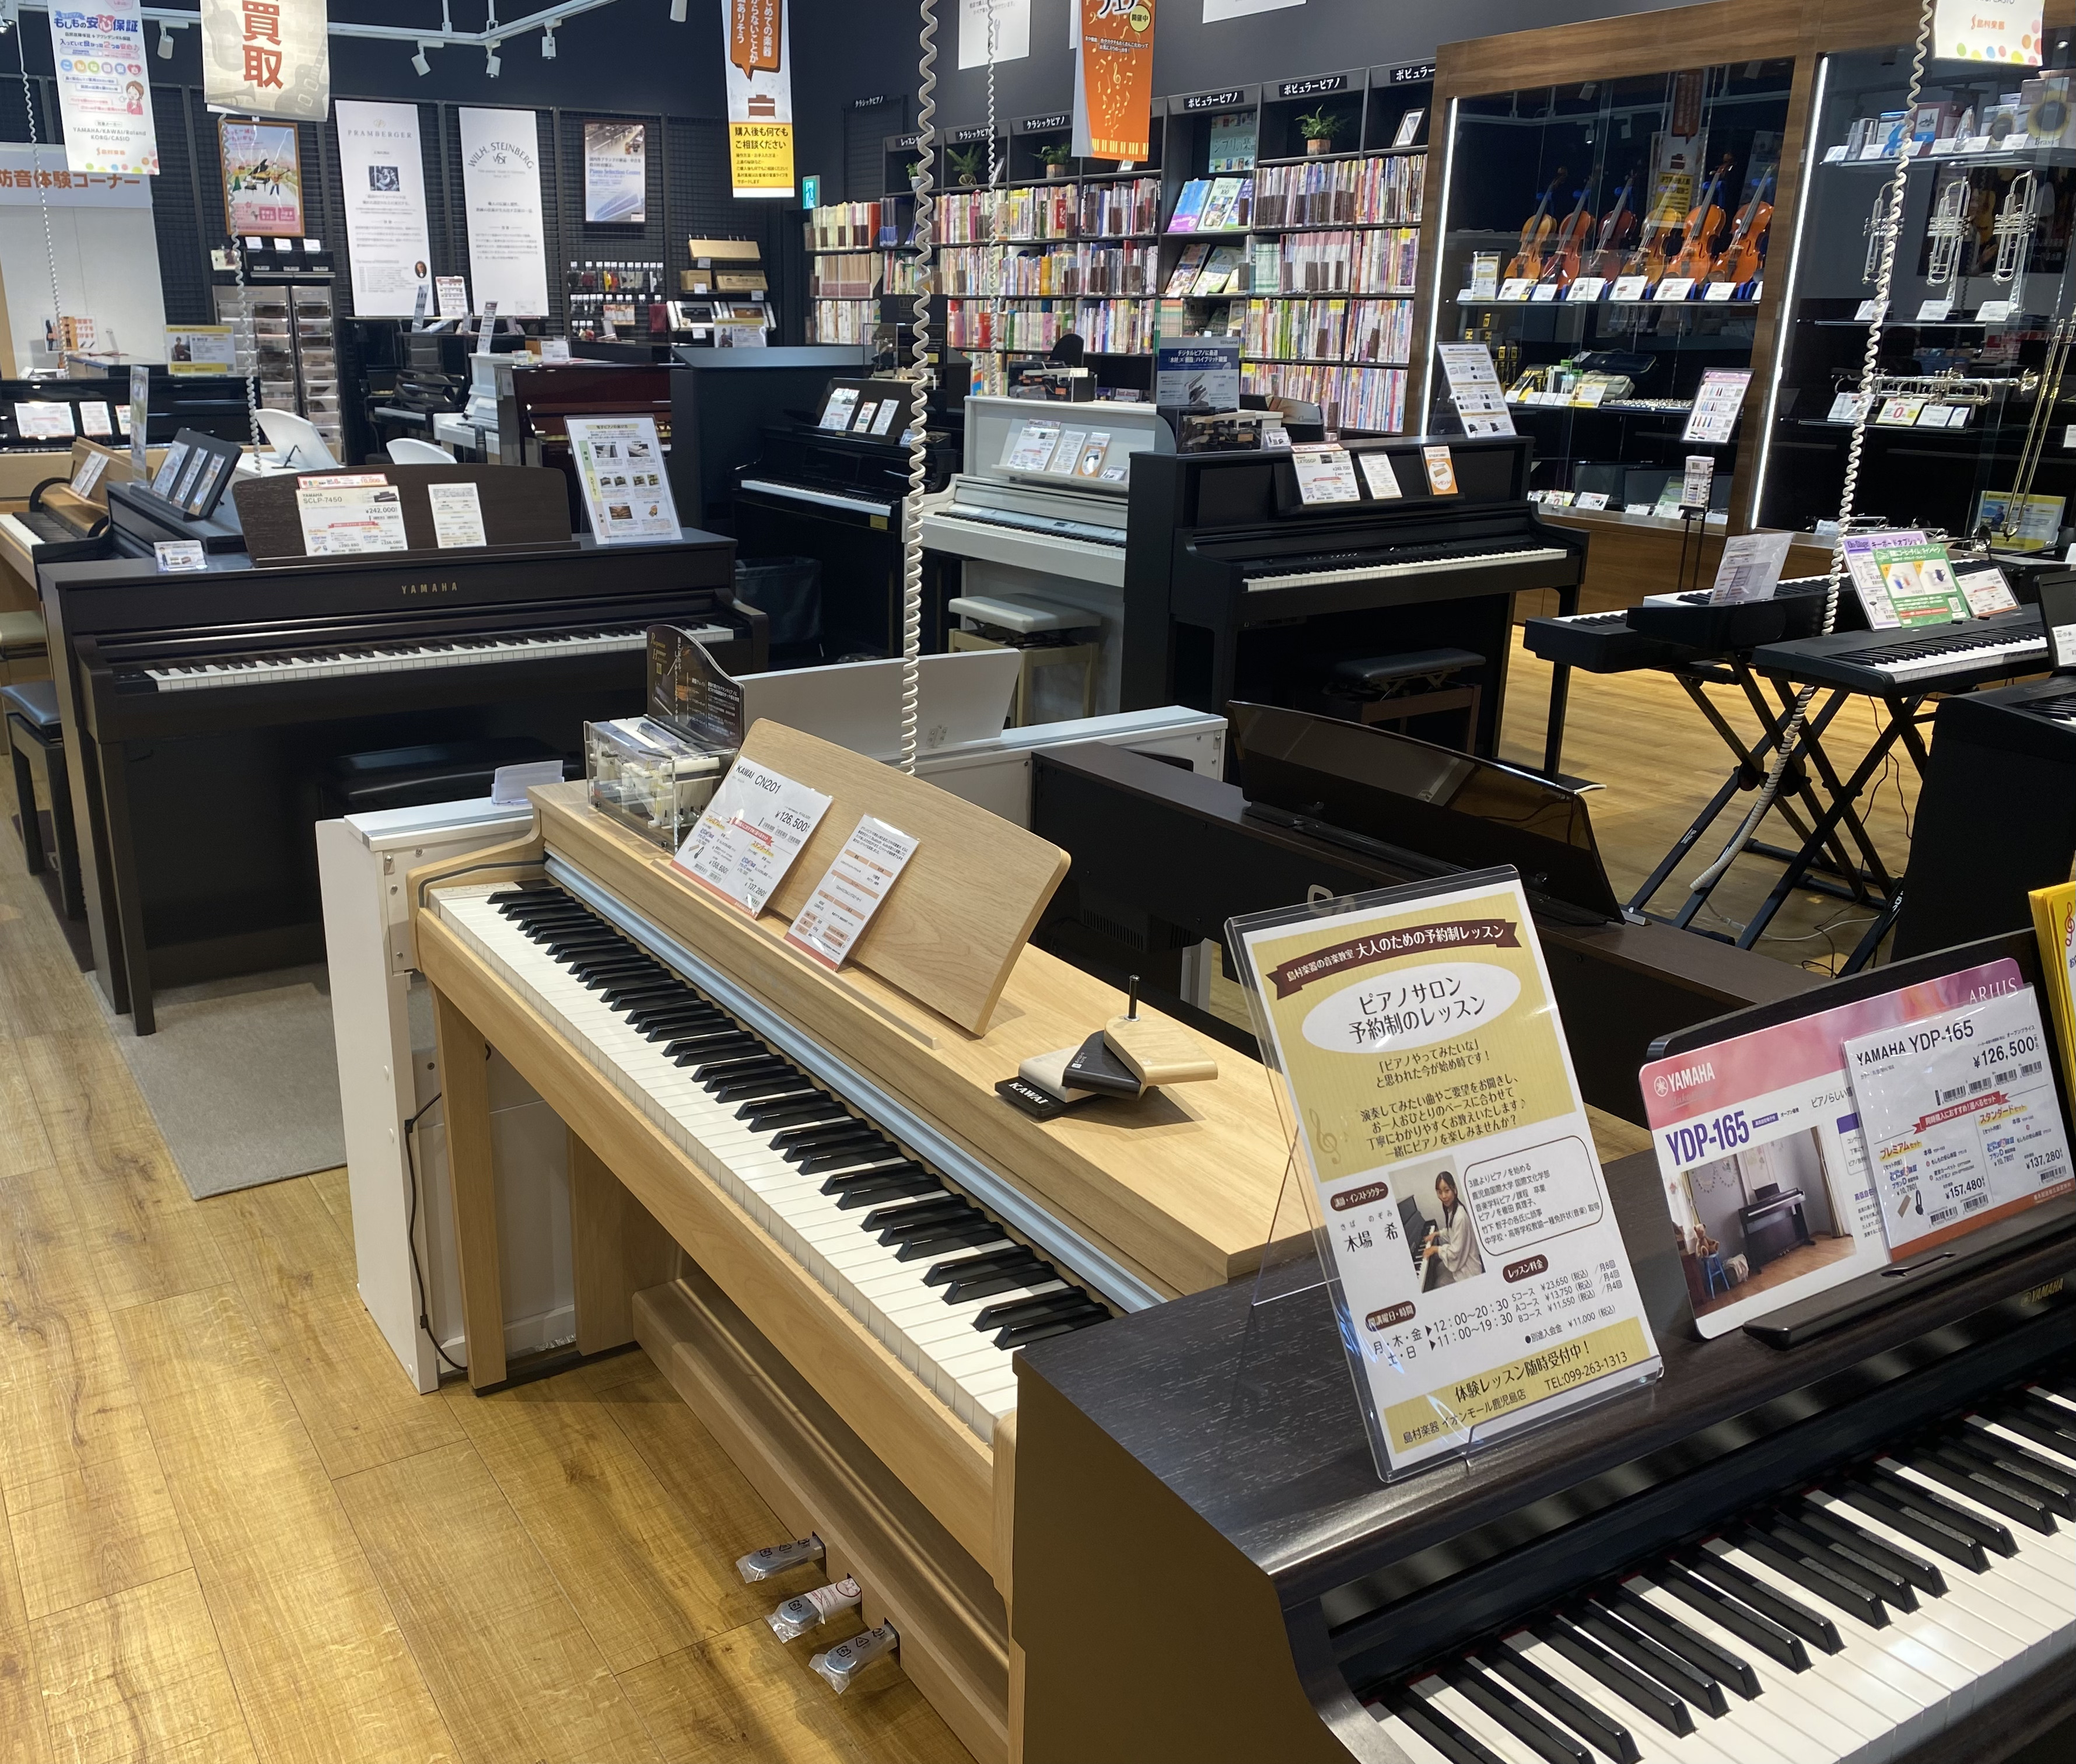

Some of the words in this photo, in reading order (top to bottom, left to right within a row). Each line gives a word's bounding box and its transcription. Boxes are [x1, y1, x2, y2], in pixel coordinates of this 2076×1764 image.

[54, 16, 138, 32] もしもの安心保証
[1284, 77, 1340, 96] ポピュラーピアノ
[855, 96, 884, 108] クラシックピアノ
[1188, 92, 1239, 108] ポピュラーピアノ
[73, 127, 146, 135] YAMAHA/KAWAI/Roland
[348, 130, 412, 139] PRAMBERGER
[735, 127, 788, 136] 購入後も何でも
[959, 127, 990, 141] クラシックピア
[1027, 116, 1065, 129] クラシックピアノ
[491, 142, 534, 169] STEINBERG
[736, 140, 786, 149] ご相談ください
[401, 582, 457, 594] YAMAHA
[736, 765, 755, 779] KAWAI
[755, 775, 782, 794] CN201
[775, 810, 808, 832] ¥126,500
[1287, 949, 1354, 982] 島村楽器の音楽教室
[1356, 925, 1504, 959] 大人のための予約制レッスン
[1359, 977, 1461, 1015] ピアノサロン
[1349, 996, 1485, 1044] 予約制のレッスン
[1379, 1038, 1480, 1073] 「ピアノやってみたいな」
[1857, 1041, 1906, 1066] YAMAHA
[1909, 1019, 1975, 1053] YDP-165
[1973, 1036, 2034, 1068] ¥126,500
[1376, 1051, 1490, 1088] と思われた今が始め時です！
[1667, 1062, 1716, 1092] YAMAHA
[1009, 1083, 1049, 1104] KAWAI
[1360, 1074, 1518, 1122] 演奏してみたい曲やご要望をお聞きし、
[1373, 1087, 1515, 1134] お一人おひとりのペースに合わせて
[1385, 1114, 1517, 1158] 一緒にピアノを楽しみませんか？
[1665, 1111, 1749, 1166] YDP-165
[2026, 1149, 2060, 1170] ¥137,280
[1468, 1163, 1531, 1188] 3歳よりピアノを始める
[1472, 1181, 1514, 1200] 鹿児島国際大学
[1515, 1170, 1550, 1186] 国際文化学部
[1945, 1177, 1982, 1200] ¥157,480
[1475, 1189, 1529, 1212] 音楽学科ピアノ課程
[1534, 1184, 1546, 1194] 卒業
[1344, 1230, 1373, 1252] 木場
[1384, 1222, 1398, 1240] 希
[1482, 1223, 1494, 1234] 竹下
[1507, 1259, 1545, 1278] レッスン料金
[1512, 1288, 1535, 1302] Sコース
[1541, 1276, 1569, 1292] ¥23,650
[1515, 1298, 1540, 1312] Aコース
[1545, 1286, 1573, 1301] ¥13,750
[2031, 1278, 2064, 1303] YAMAHA
[1518, 1308, 1542, 1323] Bコース
[1548, 1296, 1576, 1312] ¥11,550
[1568, 1312, 1596, 1328] ¥11,000
[1455, 1340, 1590, 1403] 体験レッスン随時受付中！
[1403, 1420, 1440, 1444] 島村楽器
[1442, 1389, 1527, 1427] イオンモール鹿児島店
[1544, 1351, 1628, 1391] TEL:099-263-1313
